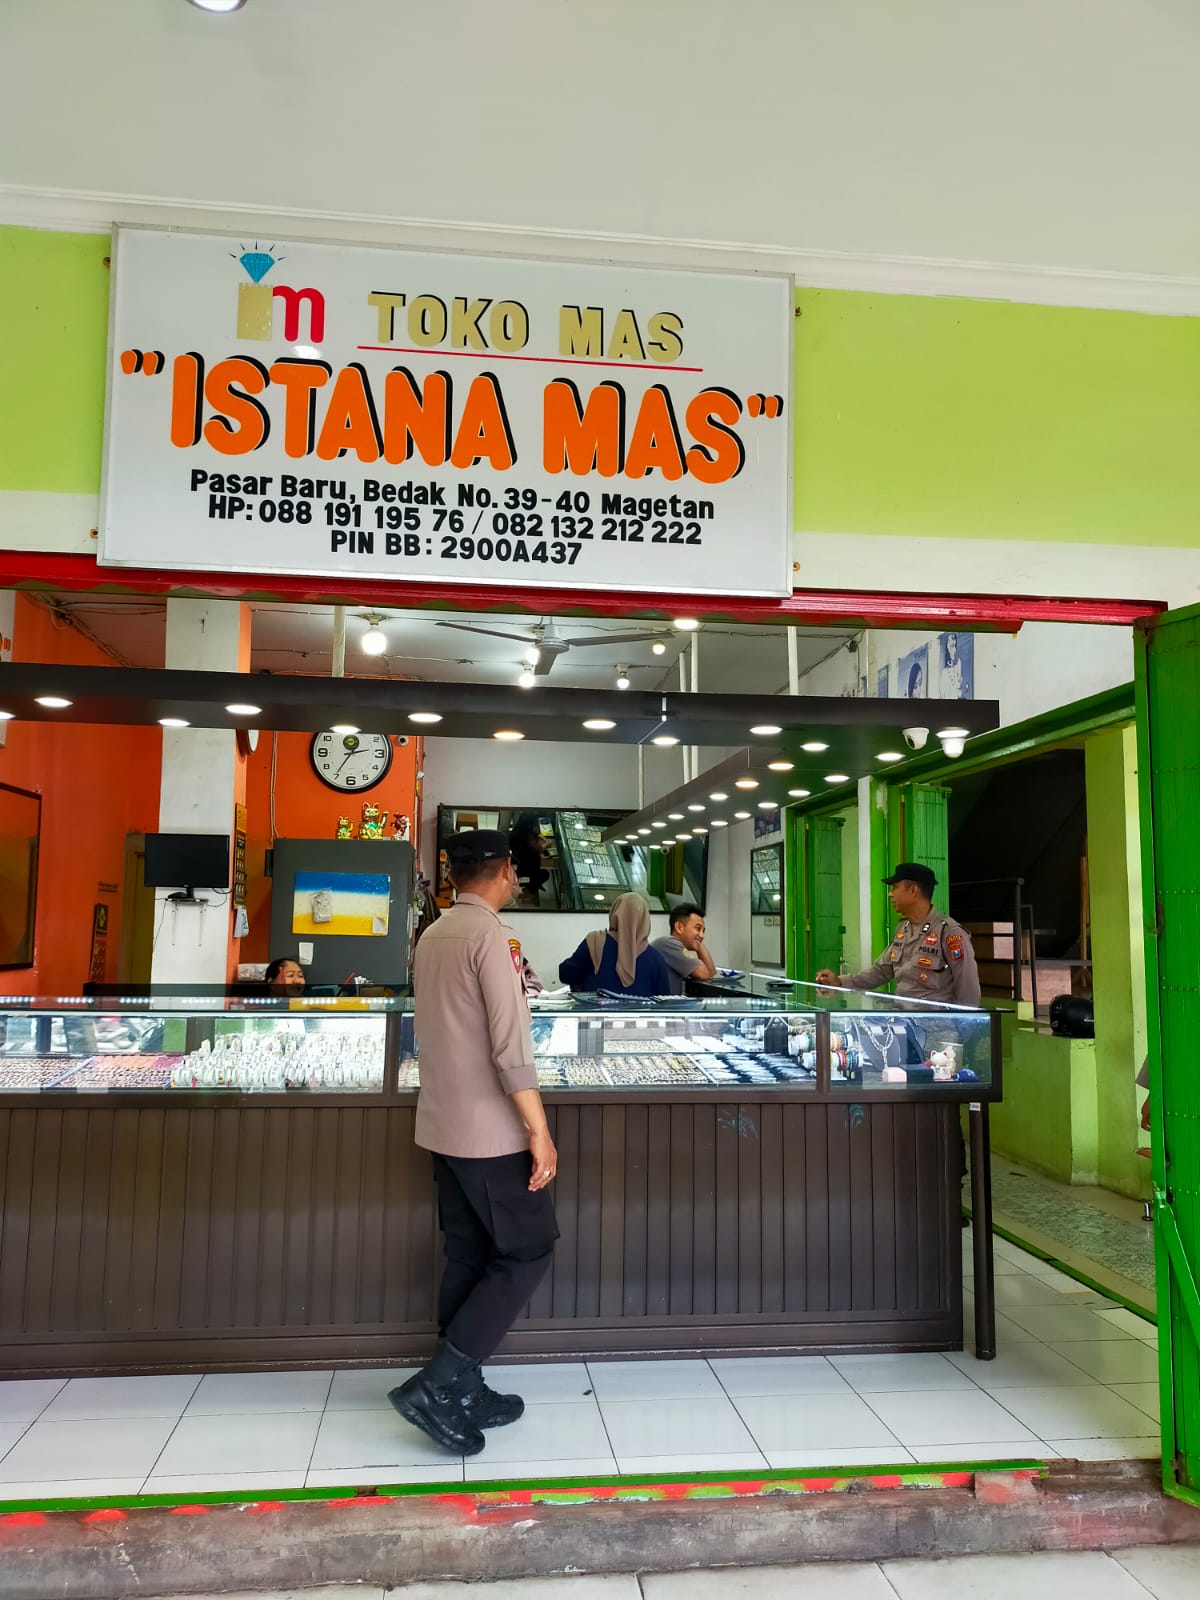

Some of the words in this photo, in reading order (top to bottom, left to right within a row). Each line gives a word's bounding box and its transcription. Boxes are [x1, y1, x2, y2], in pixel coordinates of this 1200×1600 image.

[367, 291, 530, 352] TOKO
[559, 304, 684, 363] MAS
[190, 469, 273, 495] Pasar
[280, 474, 357, 504] Baru,
[363, 479, 446, 505] Bedak
[601, 493, 715, 521] Magetan
[324, 502, 362, 527] 191
[375, 505, 421, 530] 195
[432, 508, 464, 533] 76
[472, 510, 484, 534] /
[492, 513, 544, 537] 082
[551, 516, 594, 539] 132
[601, 518, 644, 542] 212
[651, 521, 702, 545] 222
[331, 530, 374, 554] PIN
[441, 536, 582, 565] 2900A437
[317, 747, 328, 758] 9
[374, 749, 385, 759] 3
[345, 776, 356, 786] 6
